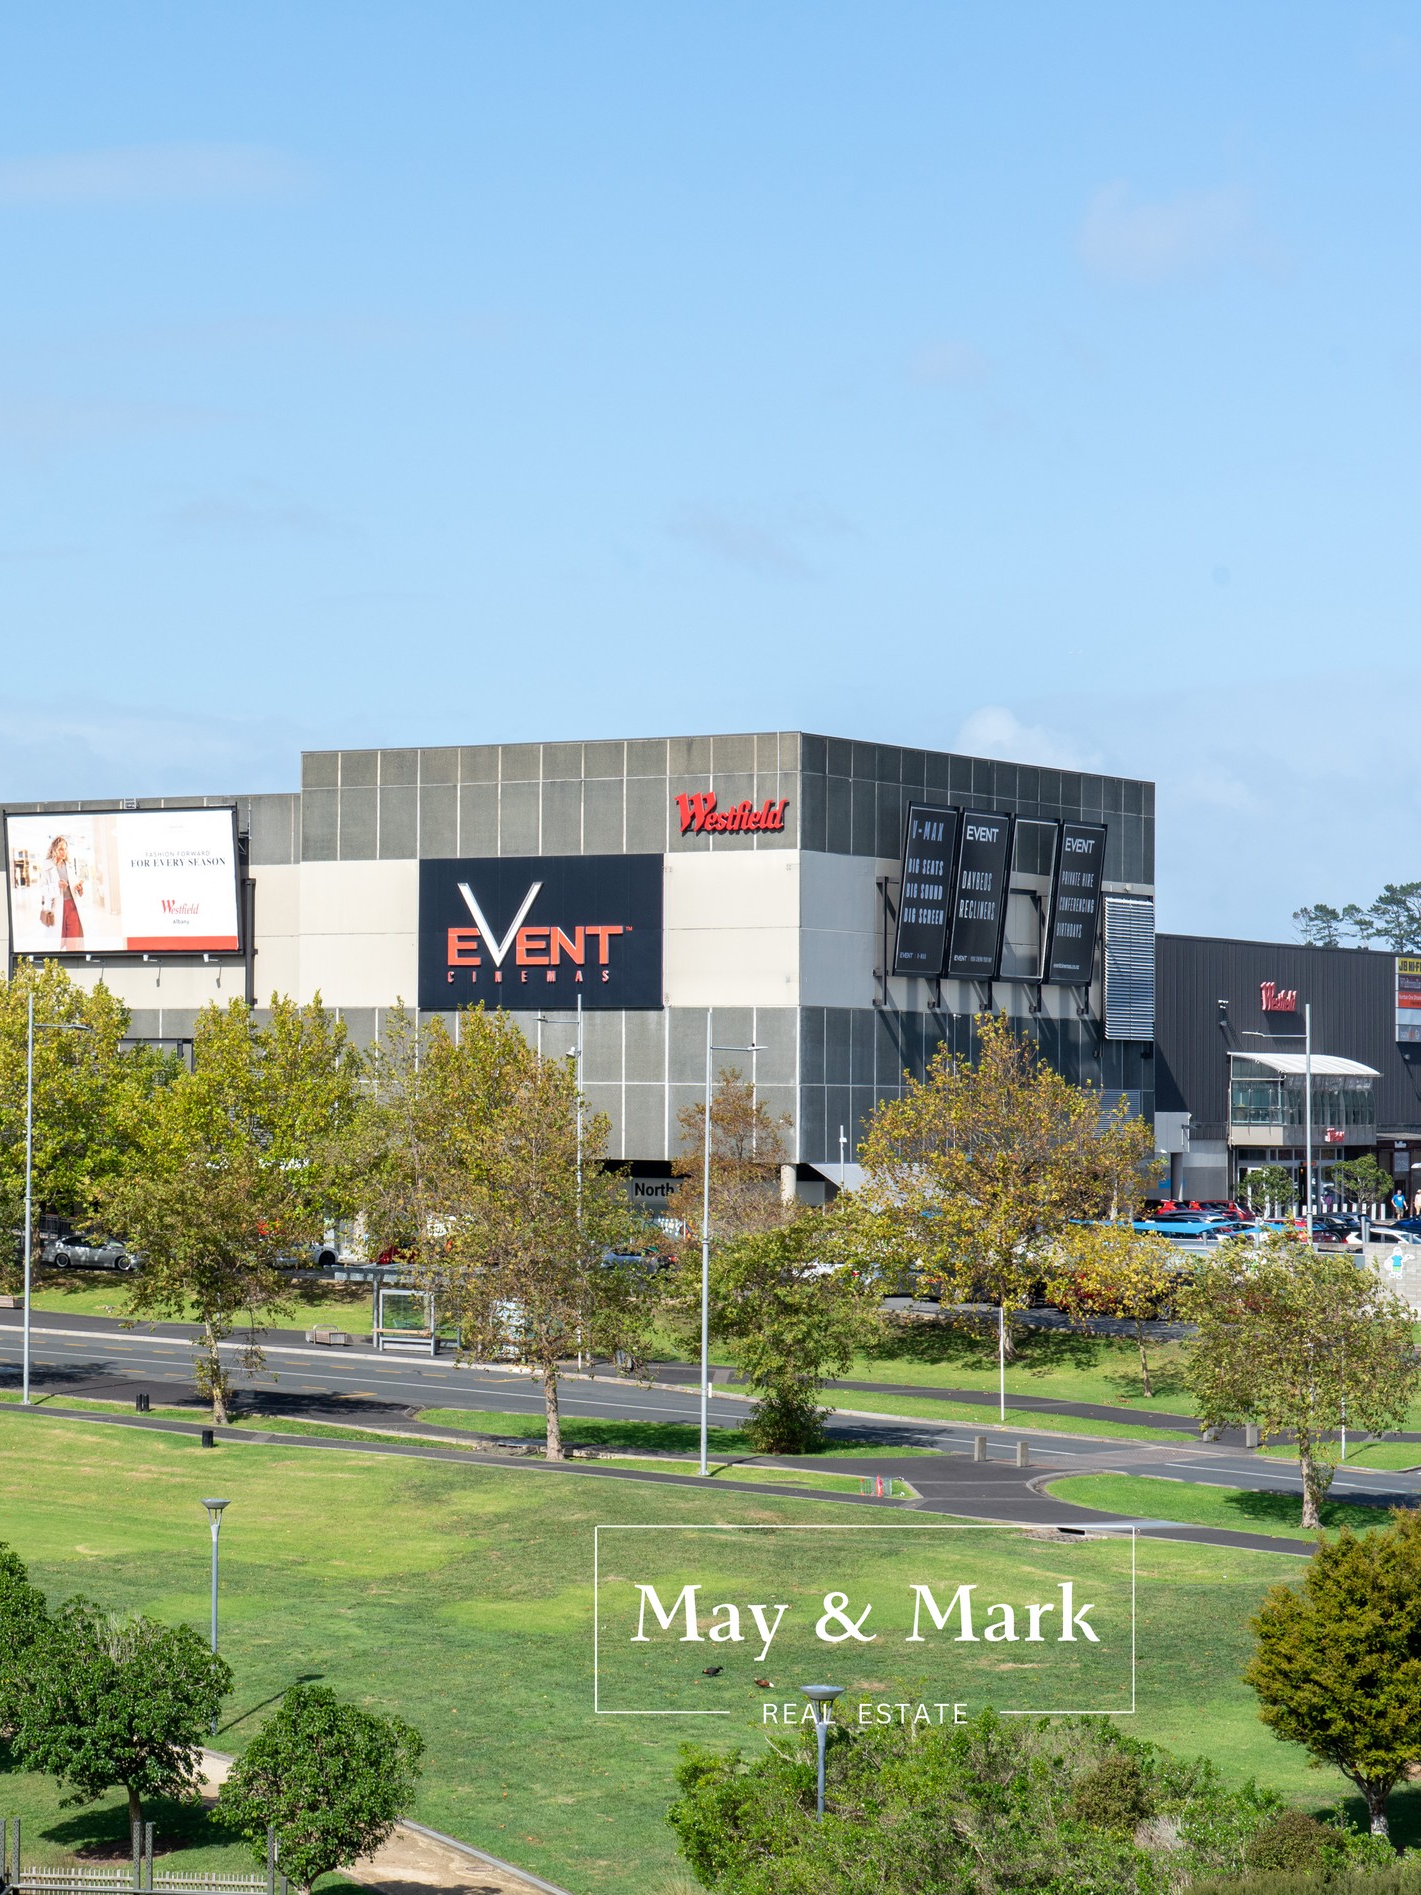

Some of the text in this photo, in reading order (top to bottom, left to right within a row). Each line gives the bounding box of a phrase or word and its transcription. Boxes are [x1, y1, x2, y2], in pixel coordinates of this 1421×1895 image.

[674, 791, 789, 833] Westfield
[912, 820, 944, 841] V-MAX
[966, 825, 999, 842] EVENT
[1065, 837, 1095, 853] EVENT
[131, 857, 226, 867] FOR EVERY SEASON
[908, 858, 944, 876] BIG SEATS
[962, 870, 992, 891] DAYBEDS
[906, 883, 943, 900] BIG SOUND
[162, 899, 200, 914] Westfield
[959, 899, 996, 921] RECLINERS
[448, 882, 623, 967] EVENT
[904, 908, 944, 925] BIG SCREEN
[447, 970, 609, 983] CINEMAS
[635, 1182, 674, 1197] North
